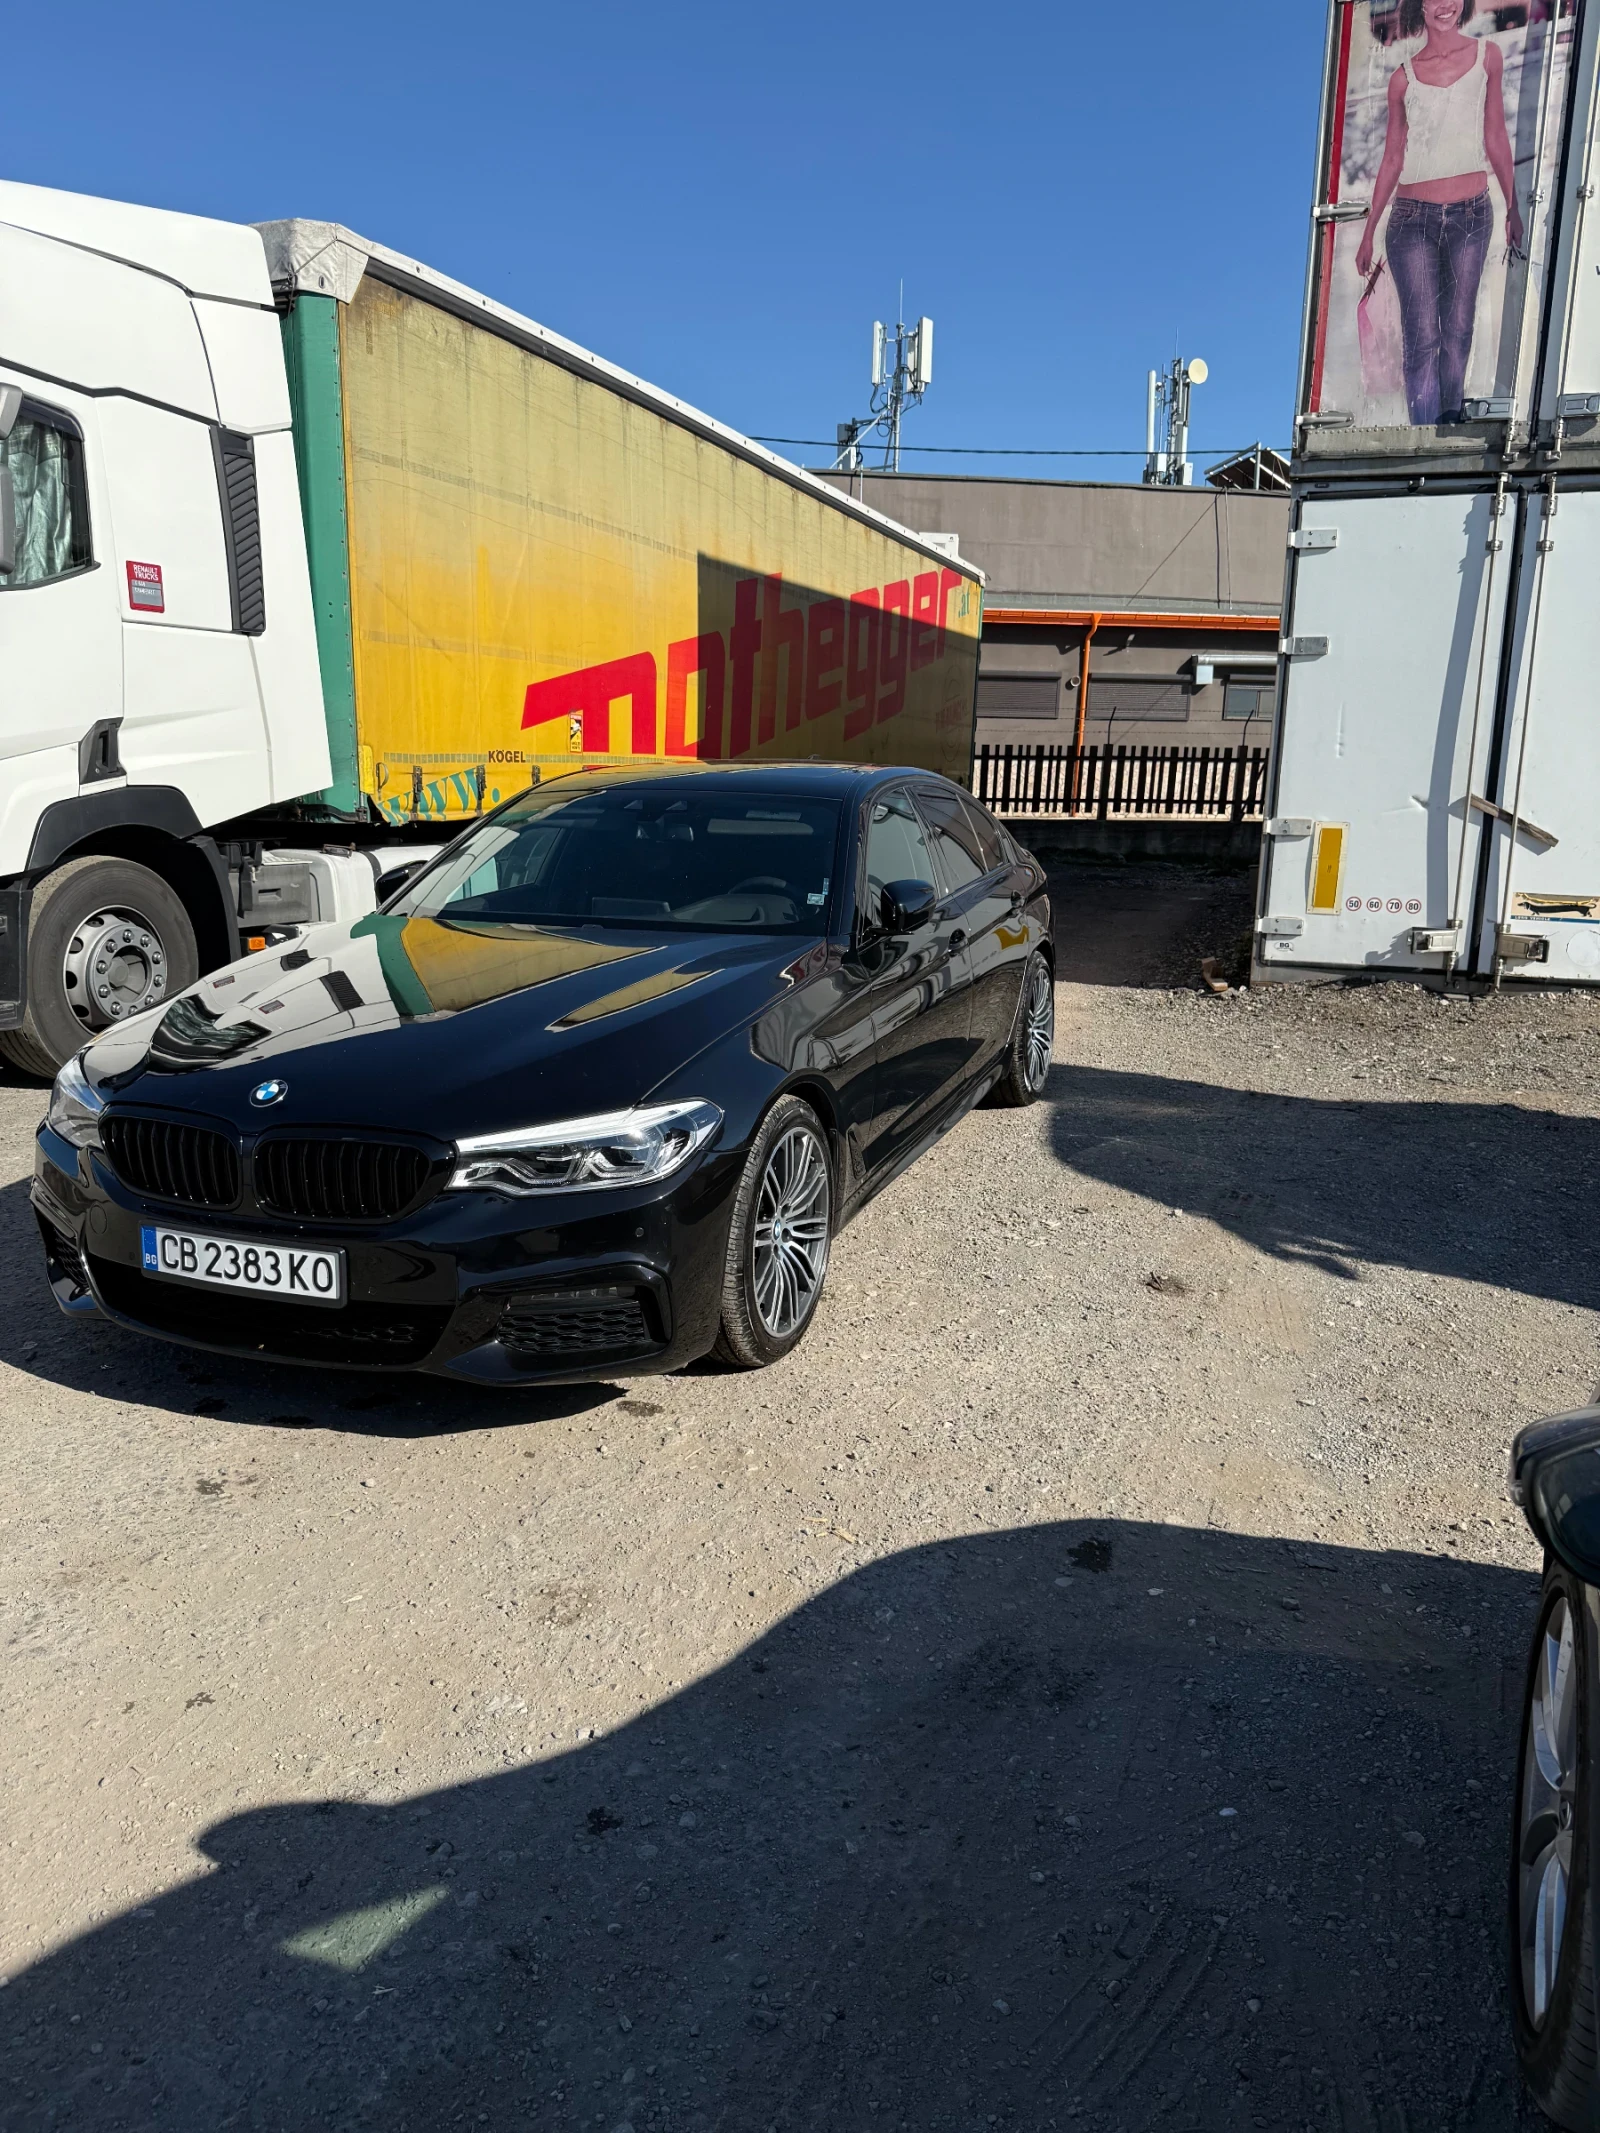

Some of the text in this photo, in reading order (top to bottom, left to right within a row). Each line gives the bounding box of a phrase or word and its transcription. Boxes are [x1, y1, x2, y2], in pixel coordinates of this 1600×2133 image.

[133, 564, 158, 574] RENAULT
[135, 572, 159, 581] TRUCKS
[488, 750, 526, 763] KÖGEL
[1348, 900, 1419, 911] 50 60 70 80
[145, 1253, 157, 1265] BG
[161, 1234, 198, 1273] CB
[205, 1242, 282, 1286] 2383
